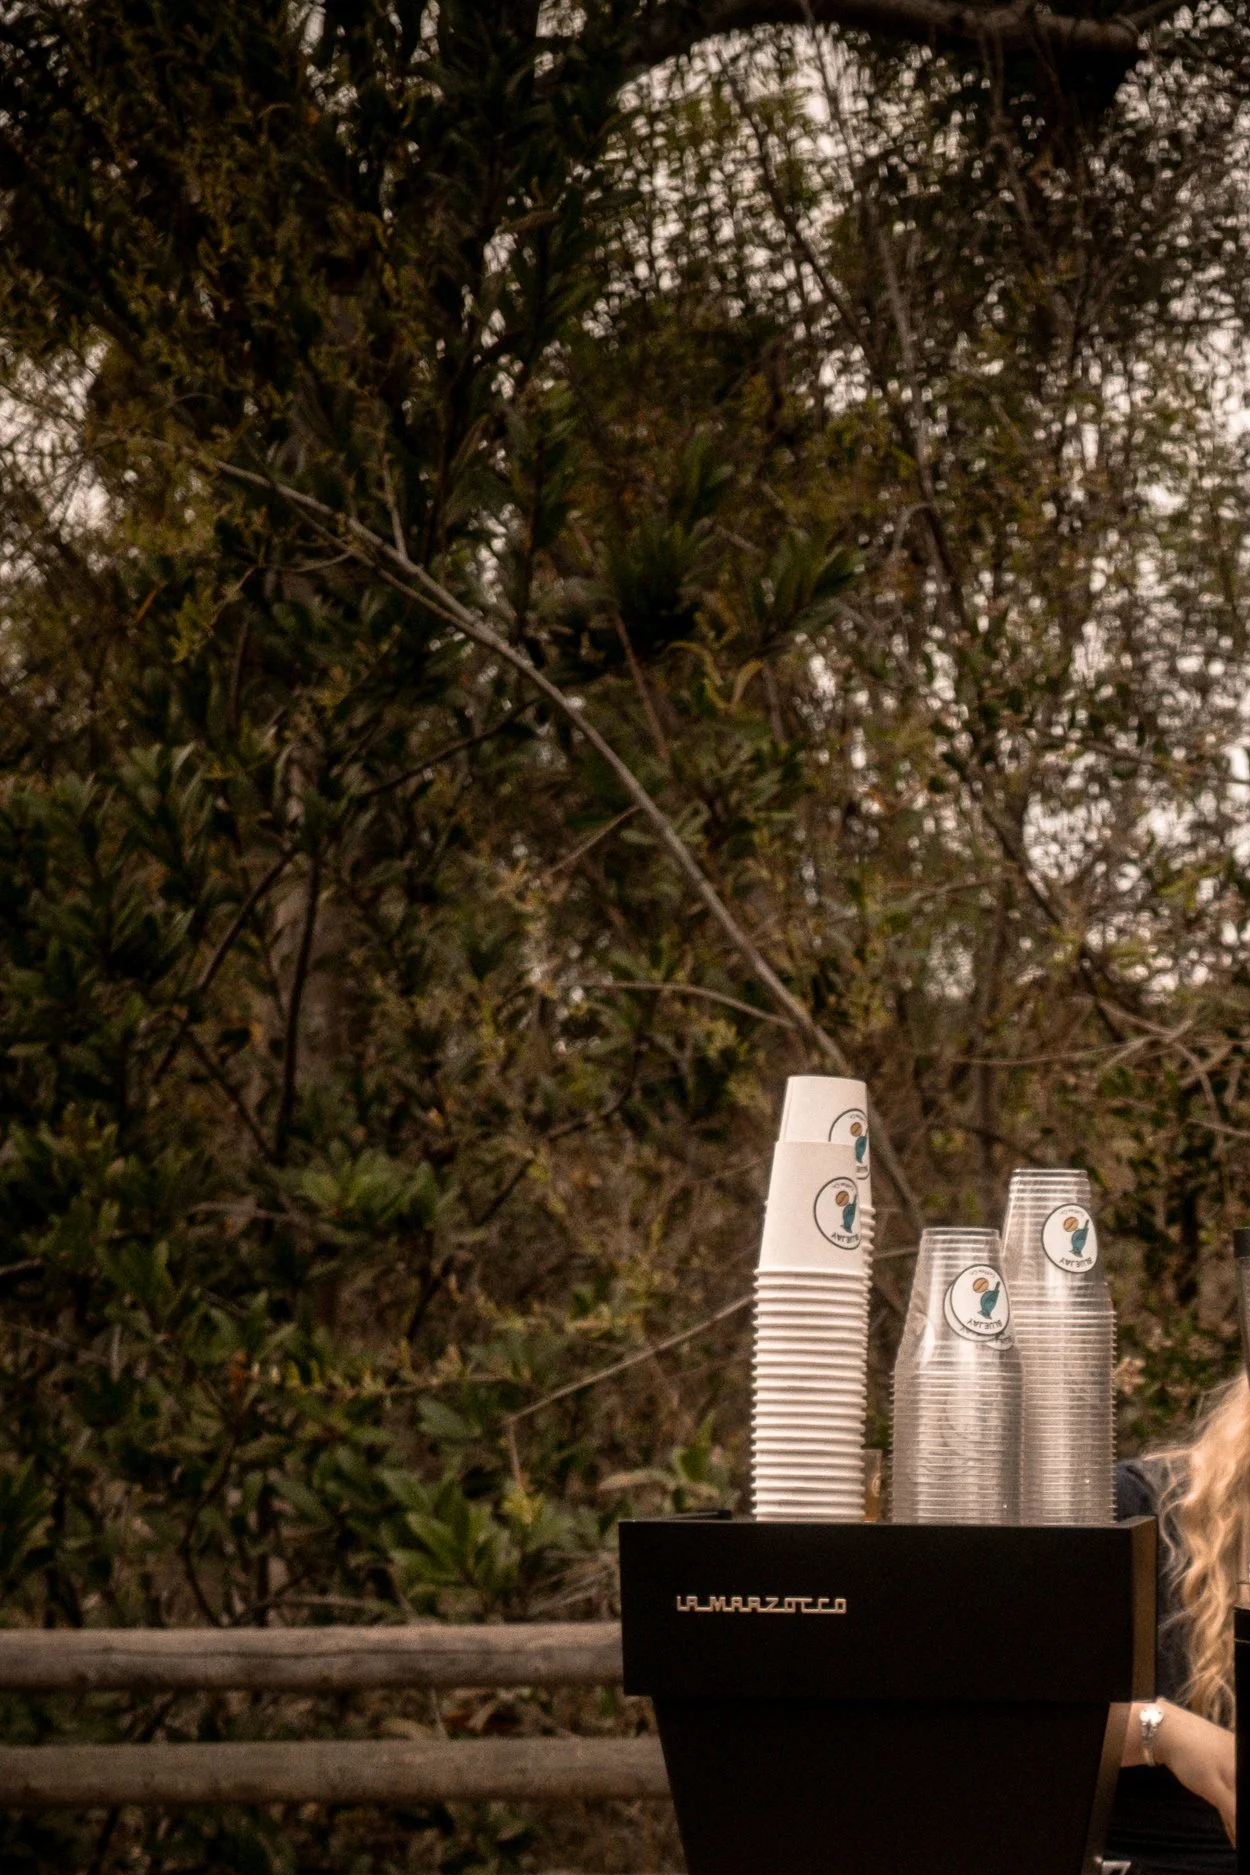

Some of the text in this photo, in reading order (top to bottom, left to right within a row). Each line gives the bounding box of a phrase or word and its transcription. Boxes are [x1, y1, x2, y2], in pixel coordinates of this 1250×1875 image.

[1059, 1256, 1093, 1268] BLUEJAY
[967, 1318, 1003, 1330] BLUEJAY
[676, 1595, 847, 1615] LA MARZOCCO
